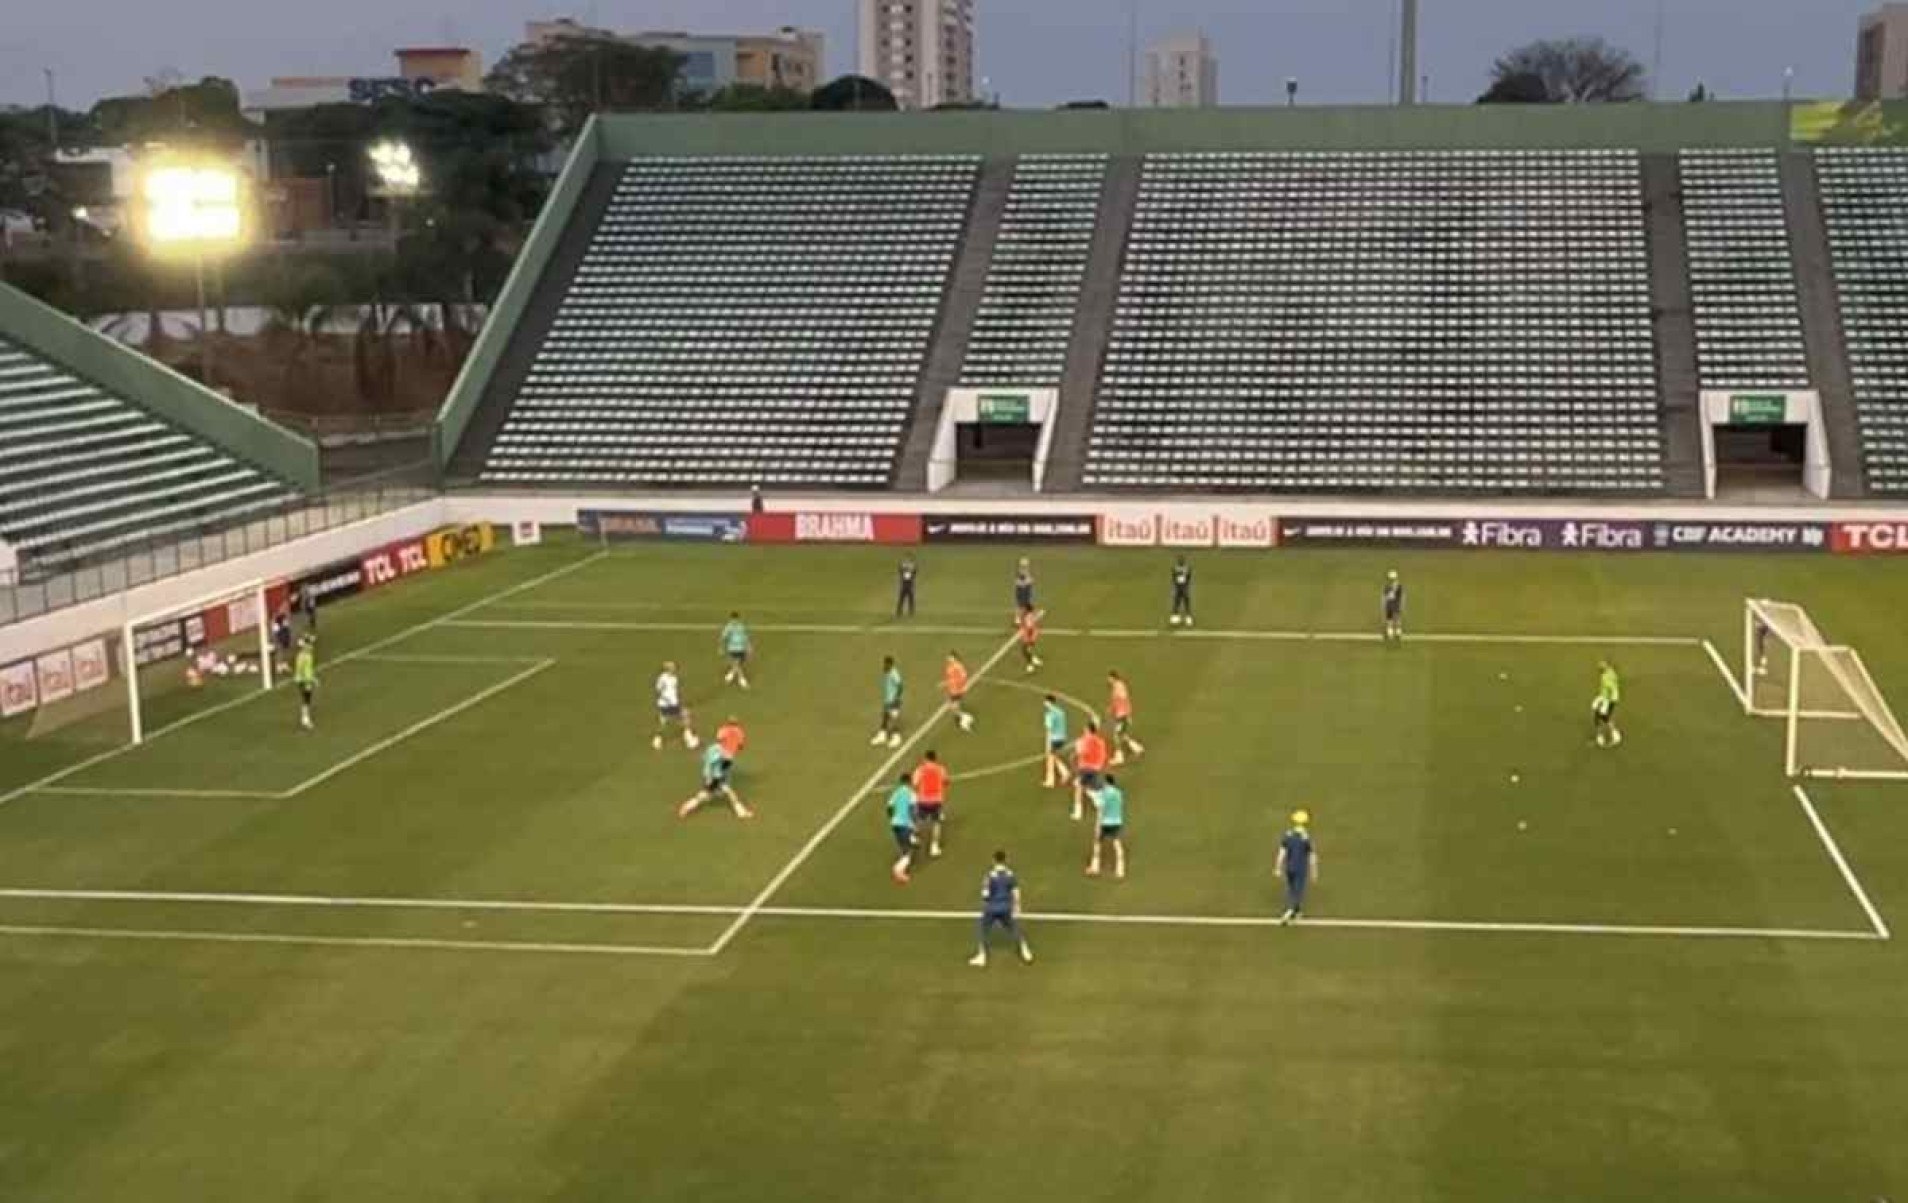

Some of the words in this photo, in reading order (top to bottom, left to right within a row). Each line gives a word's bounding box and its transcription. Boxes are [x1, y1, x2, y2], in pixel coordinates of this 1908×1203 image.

[795, 513, 873, 540] BRAHMA
[1223, 519, 1267, 541] itaú
[1481, 522, 1542, 547] Fibra
[1581, 522, 1642, 549] Fibra
[1708, 526, 1799, 543] ACADEMY
[364, 553, 396, 585] TCL
